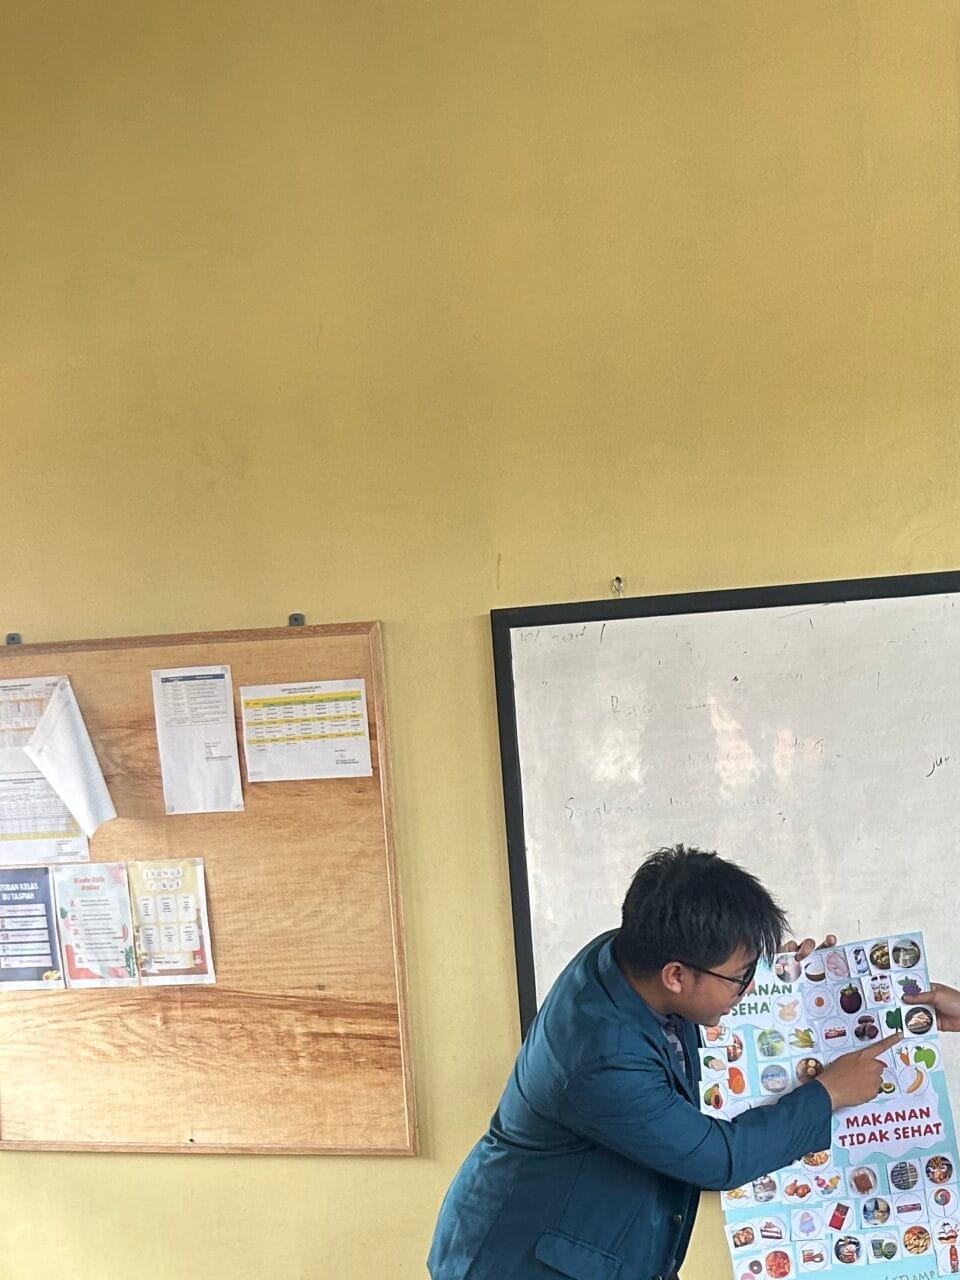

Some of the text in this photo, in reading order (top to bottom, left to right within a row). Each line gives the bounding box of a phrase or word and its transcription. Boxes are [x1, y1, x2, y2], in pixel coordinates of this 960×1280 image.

[746, 983, 793, 997] ANAN
[731, 1001, 771, 1017] SEHA
[846, 1106, 931, 1130] MAKANAN
[839, 1122, 942, 1147] TIDAK SEHAT
